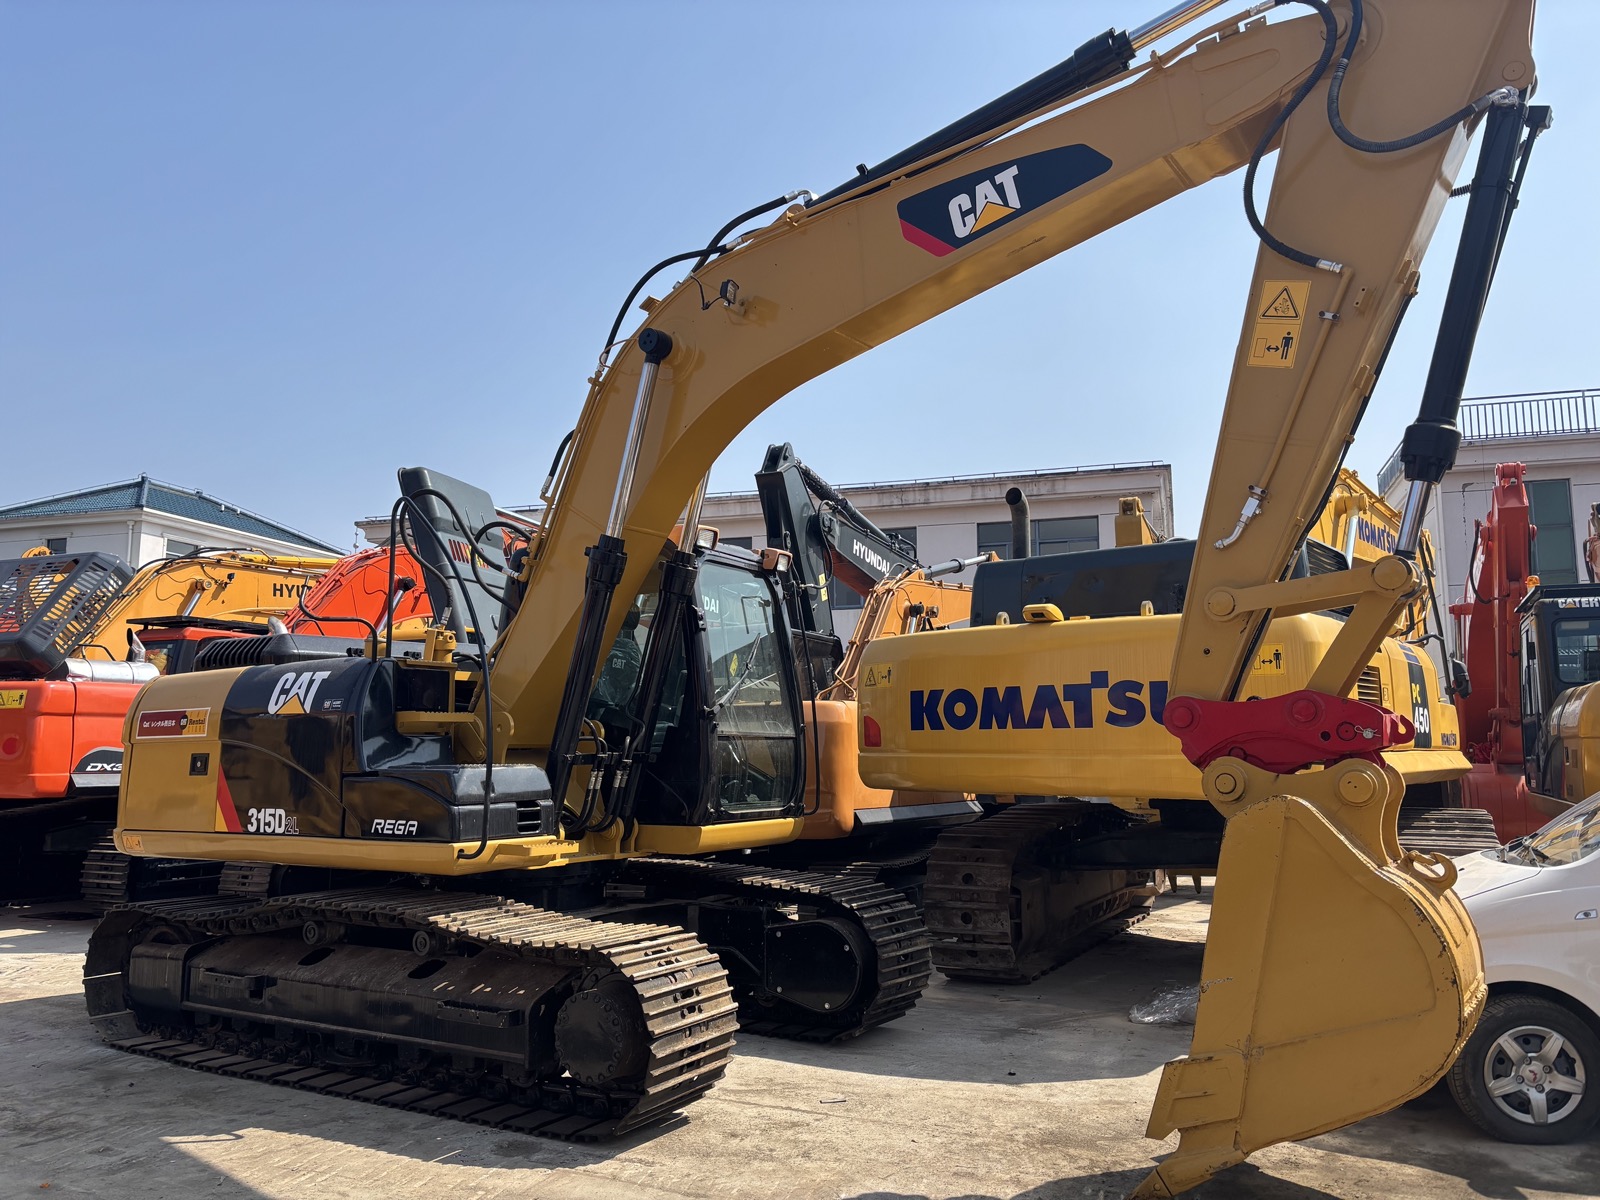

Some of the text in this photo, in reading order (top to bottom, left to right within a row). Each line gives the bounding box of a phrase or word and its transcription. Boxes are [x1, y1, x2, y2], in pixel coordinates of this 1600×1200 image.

[949, 165, 1021, 238] CAT
[1358, 516, 1396, 553] KOMATSU
[853, 539, 890, 575] HYUNDAI
[702, 595, 719, 614] DAI
[1558, 597, 1600, 608] CATER
[268, 671, 331, 714] CAT
[1411, 683, 1421, 703] PC
[1414, 706, 1429, 734] 450
[371, 819, 418, 836] REGA
